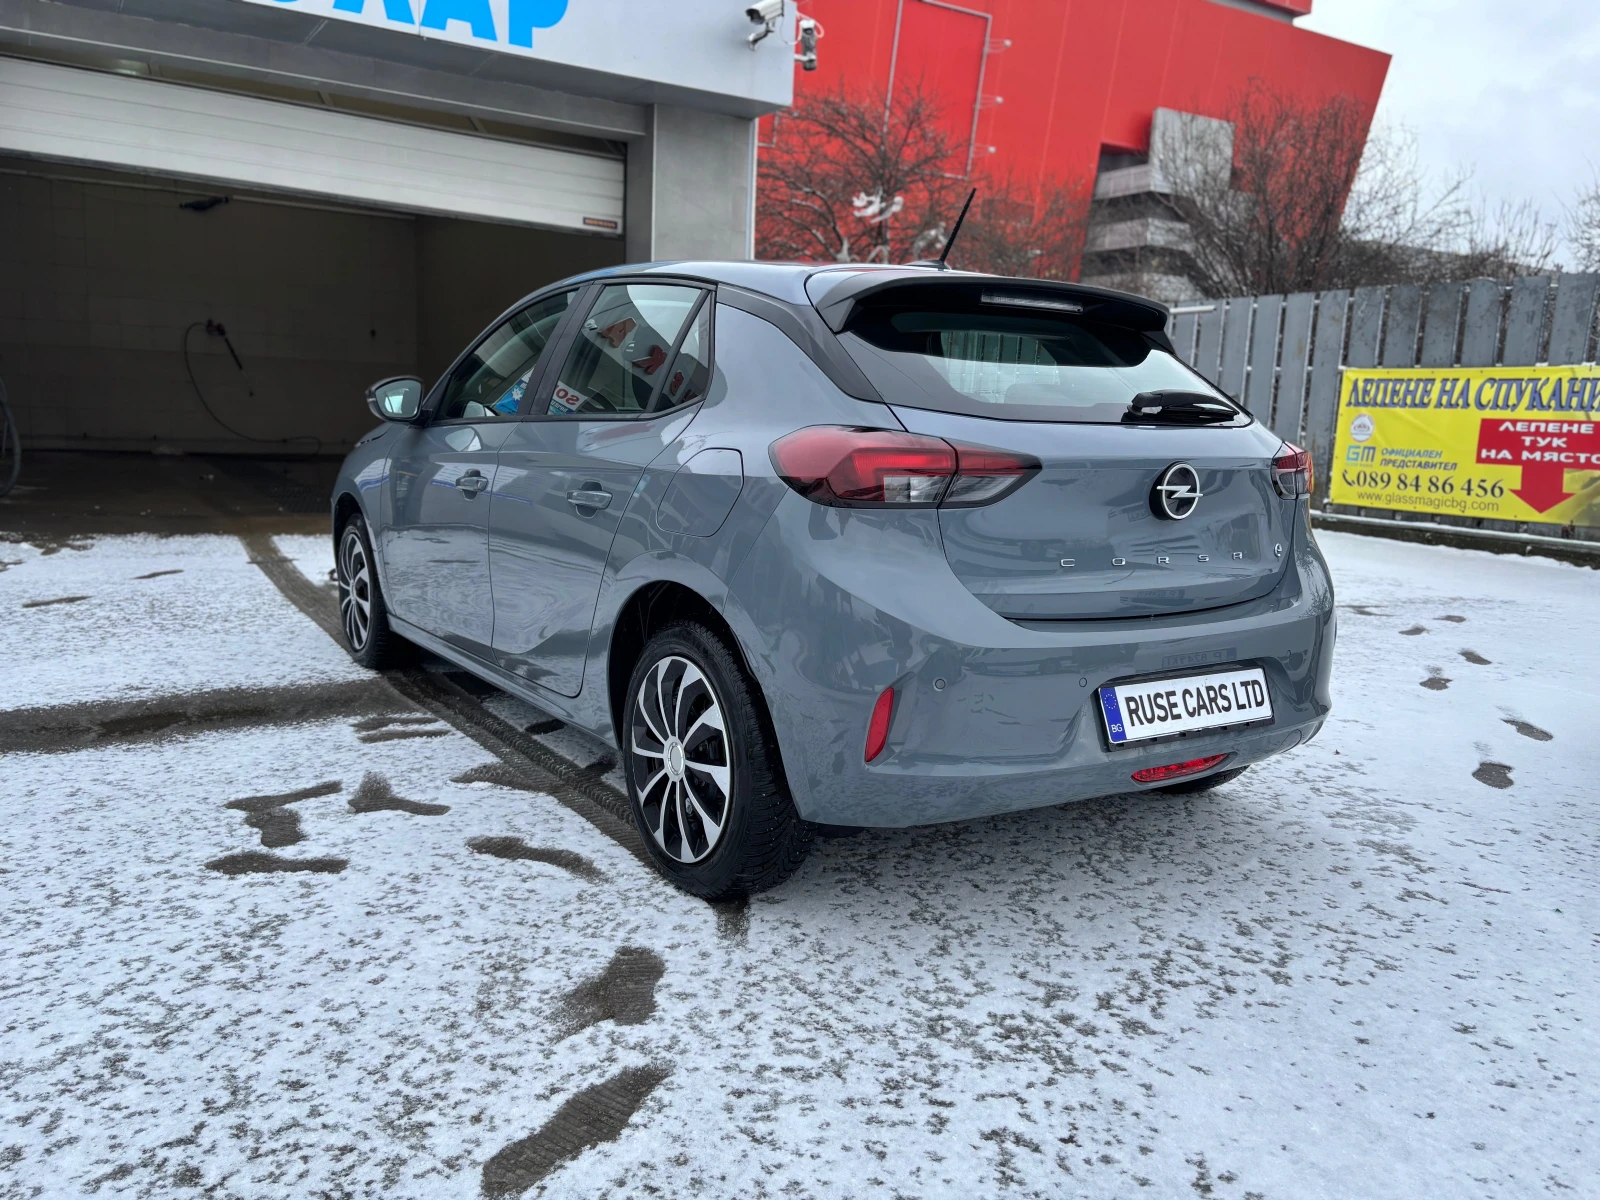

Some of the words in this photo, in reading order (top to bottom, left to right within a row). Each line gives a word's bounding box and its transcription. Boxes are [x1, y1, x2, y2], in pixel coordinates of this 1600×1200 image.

[1346, 377, 1436, 409] ЛЕПЕНЕ
[1434, 377, 1470, 409] НА
[1498, 421, 1595, 434] ЛЕПЕНЕ
[1520, 436, 1567, 448] ТУК
[1346, 445, 1376, 463] GM
[1381, 447, 1443, 459] ОФИЦИАЛЕН
[1480, 448, 1513, 460] НА
[1380, 459, 1458, 472] ПРЕДСТАВИТЕЛ
[1356, 470, 1391, 490] 089
[1396, 473, 1422, 492] 84
[1427, 475, 1454, 495] 86
[1460, 478, 1504, 499] 456
[1357, 490, 1500, 512] www.glassmagicbg.com
[1060, 551, 1243, 568] CORSA
[1124, 690, 1182, 727] RUSE
[1181, 683, 1232, 718] CARS
[1231, 679, 1265, 711] LTD
[1110, 723, 1123, 733] BG
